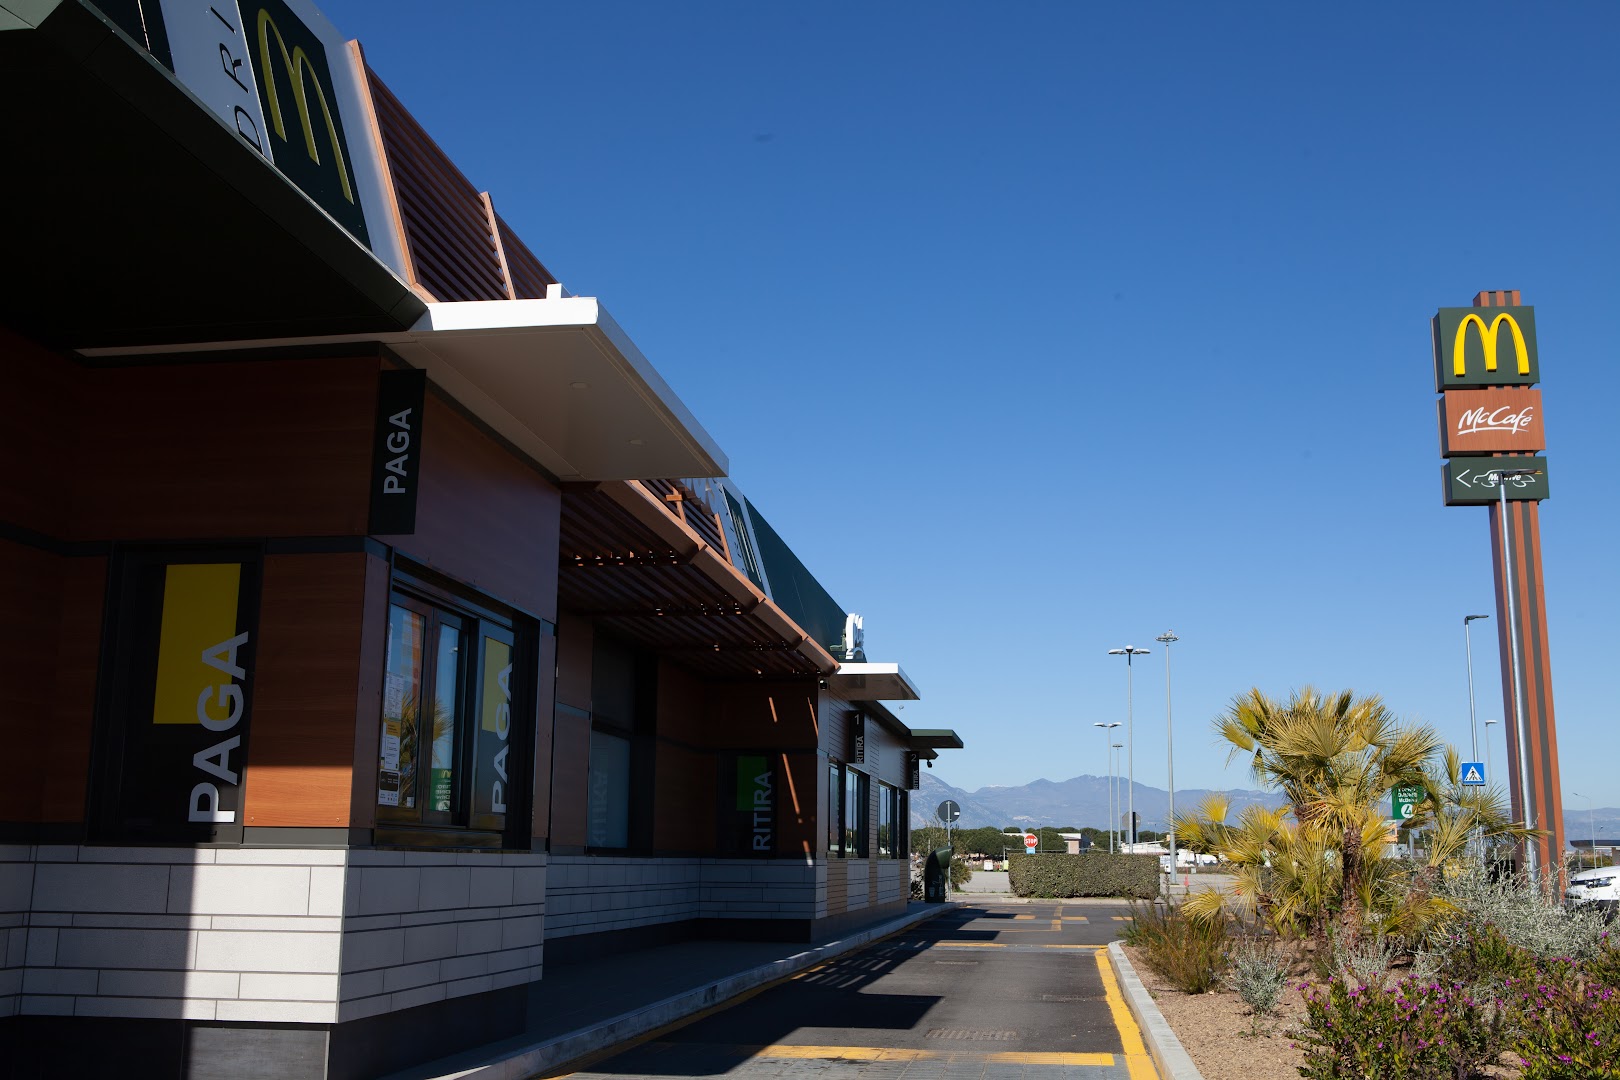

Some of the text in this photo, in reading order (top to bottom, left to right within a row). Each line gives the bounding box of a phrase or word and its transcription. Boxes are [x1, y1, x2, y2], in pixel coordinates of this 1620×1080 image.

[1456, 405, 1534, 436] McCafé
[383, 407, 412, 494] PAGA
[188, 631, 249, 823] PAGA
[491, 663, 513, 814] PAGA
[854, 713, 860, 725] 1
[856, 735, 864, 764] RITIRA
[911, 753, 917, 762] 2
[753, 770, 773, 851] RITIRA
